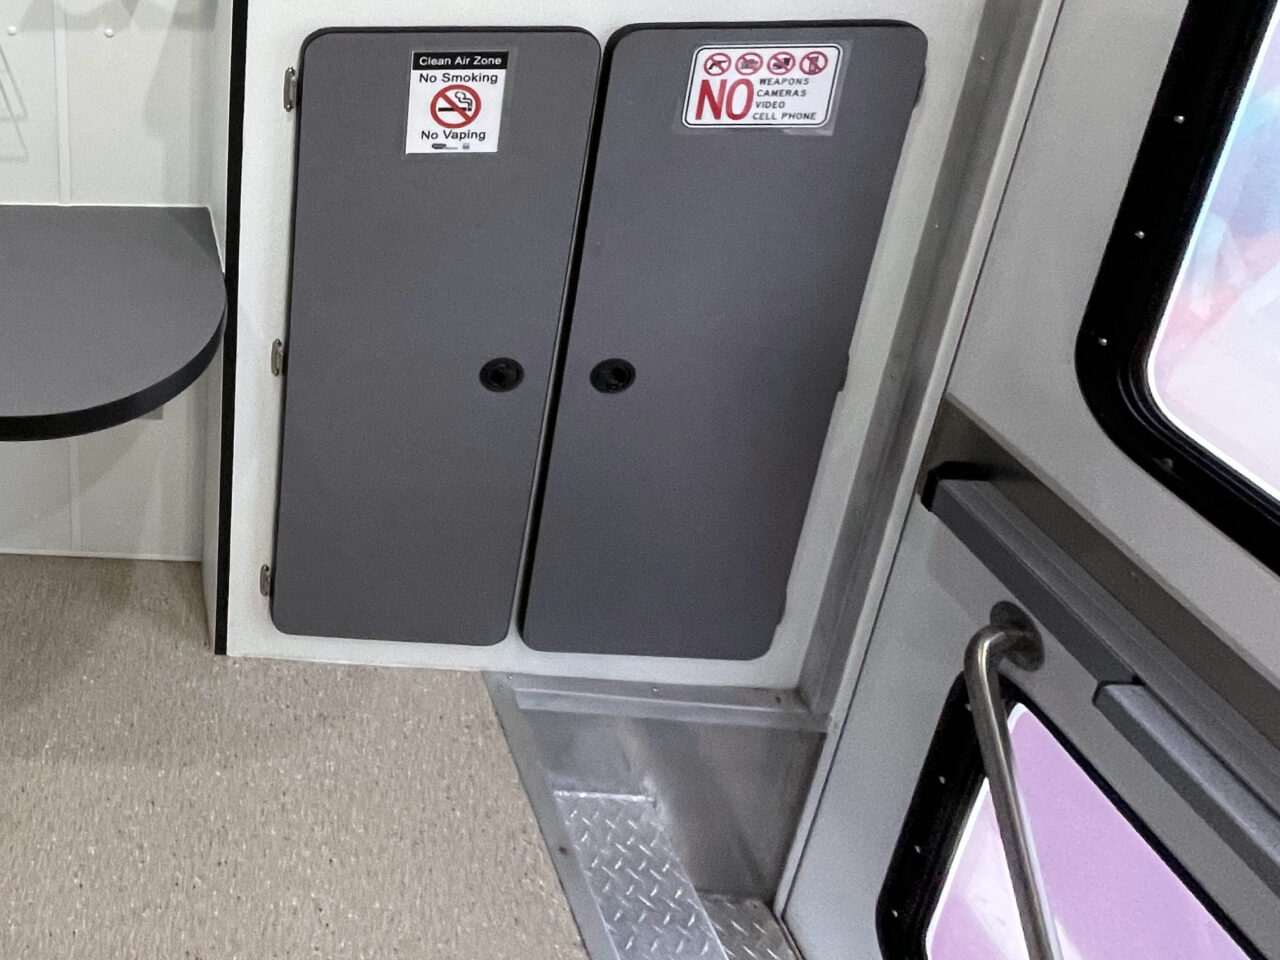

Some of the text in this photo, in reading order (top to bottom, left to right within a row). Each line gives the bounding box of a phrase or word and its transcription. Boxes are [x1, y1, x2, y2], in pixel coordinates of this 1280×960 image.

[419, 55, 502, 66] Clean Air Zone
[419, 72, 498, 84] No Smoking
[756, 89, 807, 97] CAMERAS
[695, 78, 755, 121] NO
[755, 101, 786, 109] VIDEO
[752, 112, 817, 120] CELL PHONE
[421, 129, 486, 141] No Vaping
